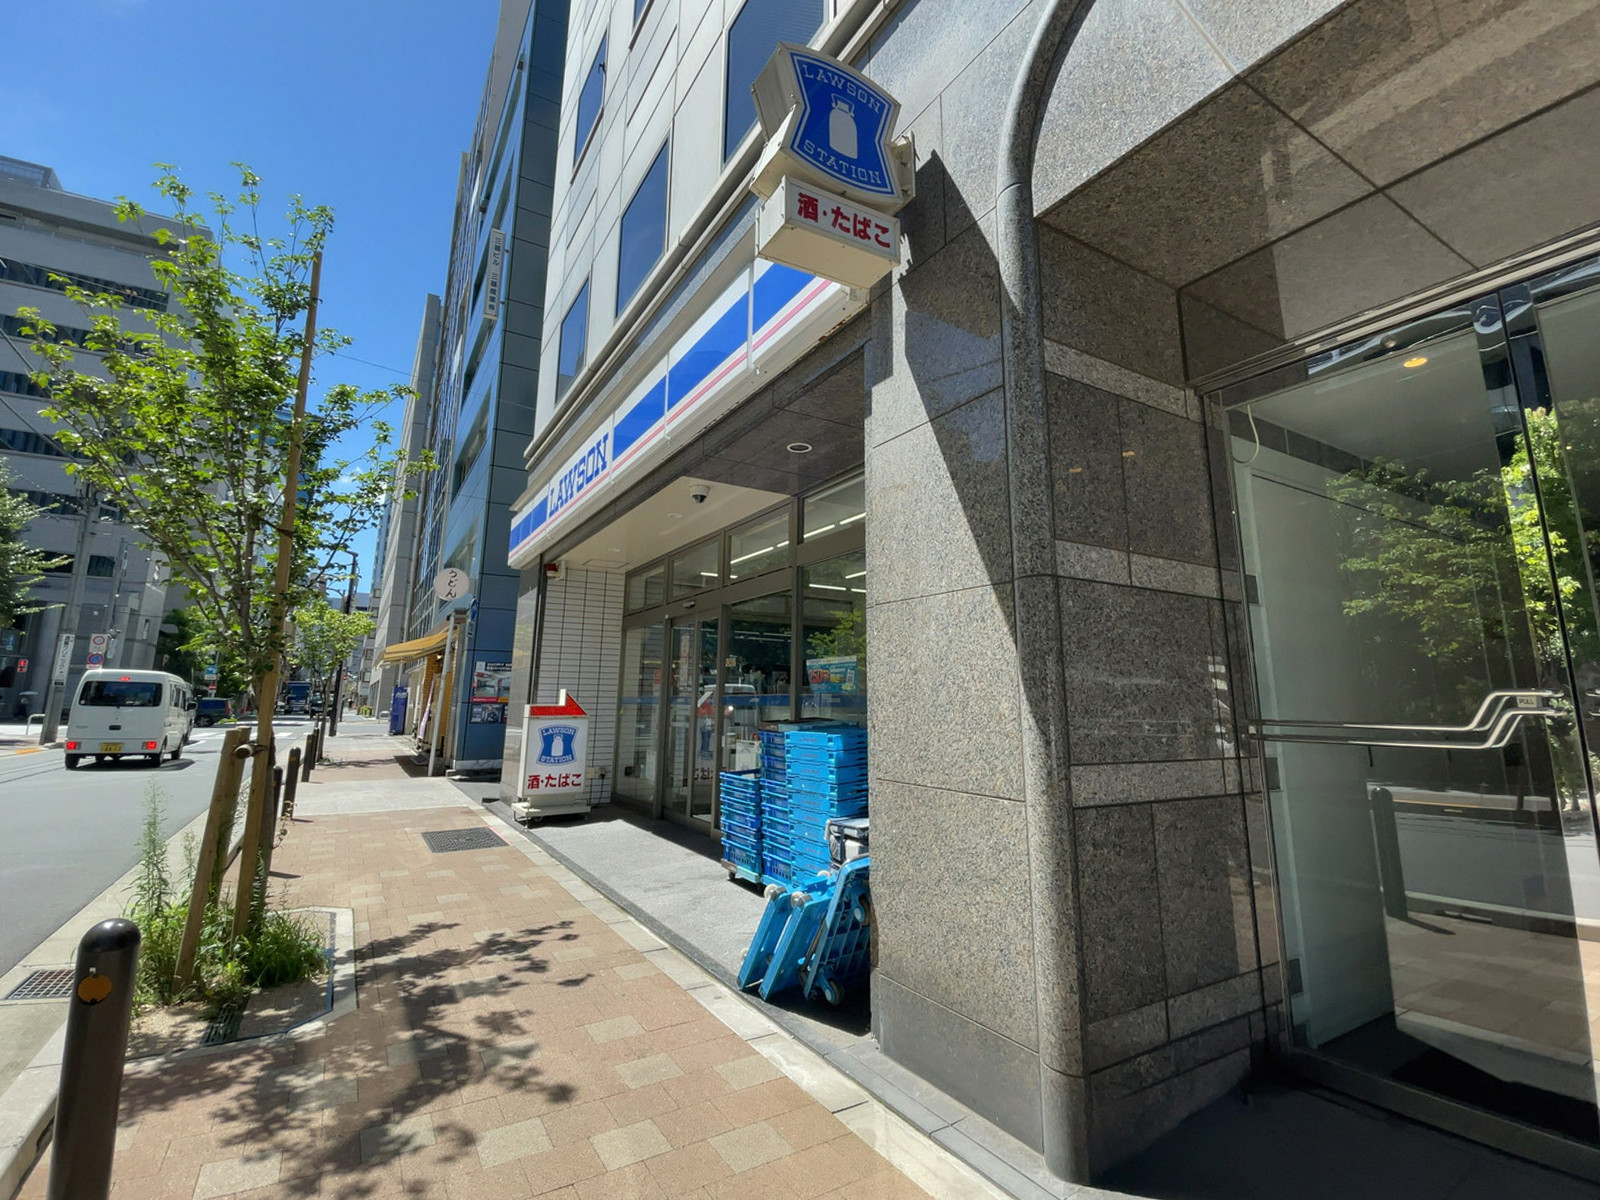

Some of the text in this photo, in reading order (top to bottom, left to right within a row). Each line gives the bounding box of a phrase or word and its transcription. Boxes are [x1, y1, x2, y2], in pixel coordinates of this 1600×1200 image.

[802, 65, 880, 113] LAWSON
[803, 139, 882, 183] STATION
[797, 192, 891, 248] 酒・たばこ
[548, 432, 609, 518] LAWSON
[446, 570, 459, 599] うどん
[543, 727, 575, 736] LAWSON
[540, 754, 573, 764] STATION
[527, 773, 582, 789] 酒・たばこ
